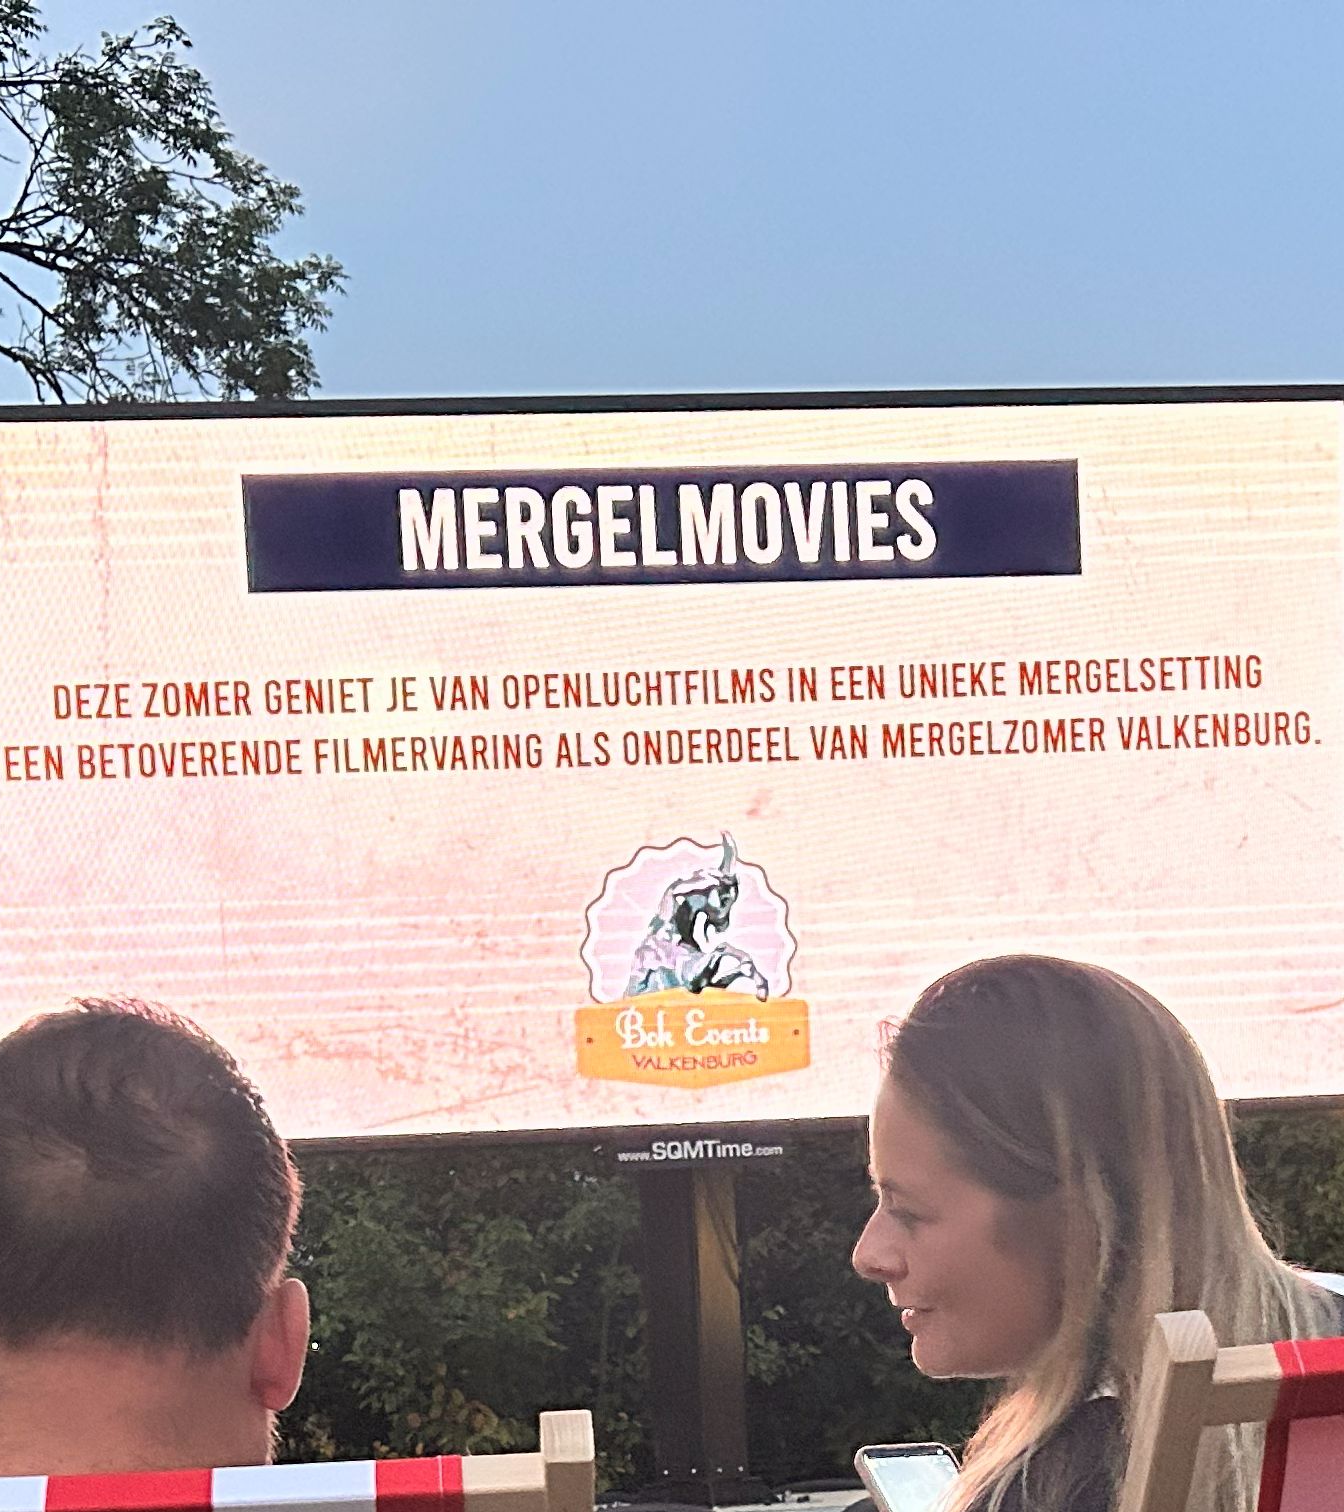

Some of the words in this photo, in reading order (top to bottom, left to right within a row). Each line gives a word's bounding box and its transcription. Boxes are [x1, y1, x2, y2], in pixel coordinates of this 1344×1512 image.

[399, 478, 939, 573] MERGELMOVIES
[52, 682, 132, 721] DEZE
[141, 680, 252, 719] ZOMER
[263, 677, 374, 716] GENIET
[385, 676, 418, 714] JE
[429, 675, 490, 712] VAN
[502, 667, 776, 711] OPENLUCHTFILMS
[787, 666, 818, 703] IN
[830, 664, 886, 702] EEN
[898, 661, 1007, 700] UNIEKE
[1018, 654, 1263, 697] MERGELSETTING
[3, 744, 64, 782] EEN
[77, 739, 303, 781] BETOVERENDE
[313, 733, 543, 776] FILMERVARING
[555, 731, 611, 769] ALS
[623, 726, 800, 767] ONDERDEEL
[809, 724, 868, 762] VAN
[881, 717, 1106, 760] MERGELZOMER
[1116, 710, 1323, 752] VALKENBURG.
[631, 1050, 758, 1071] VALKENBURG
